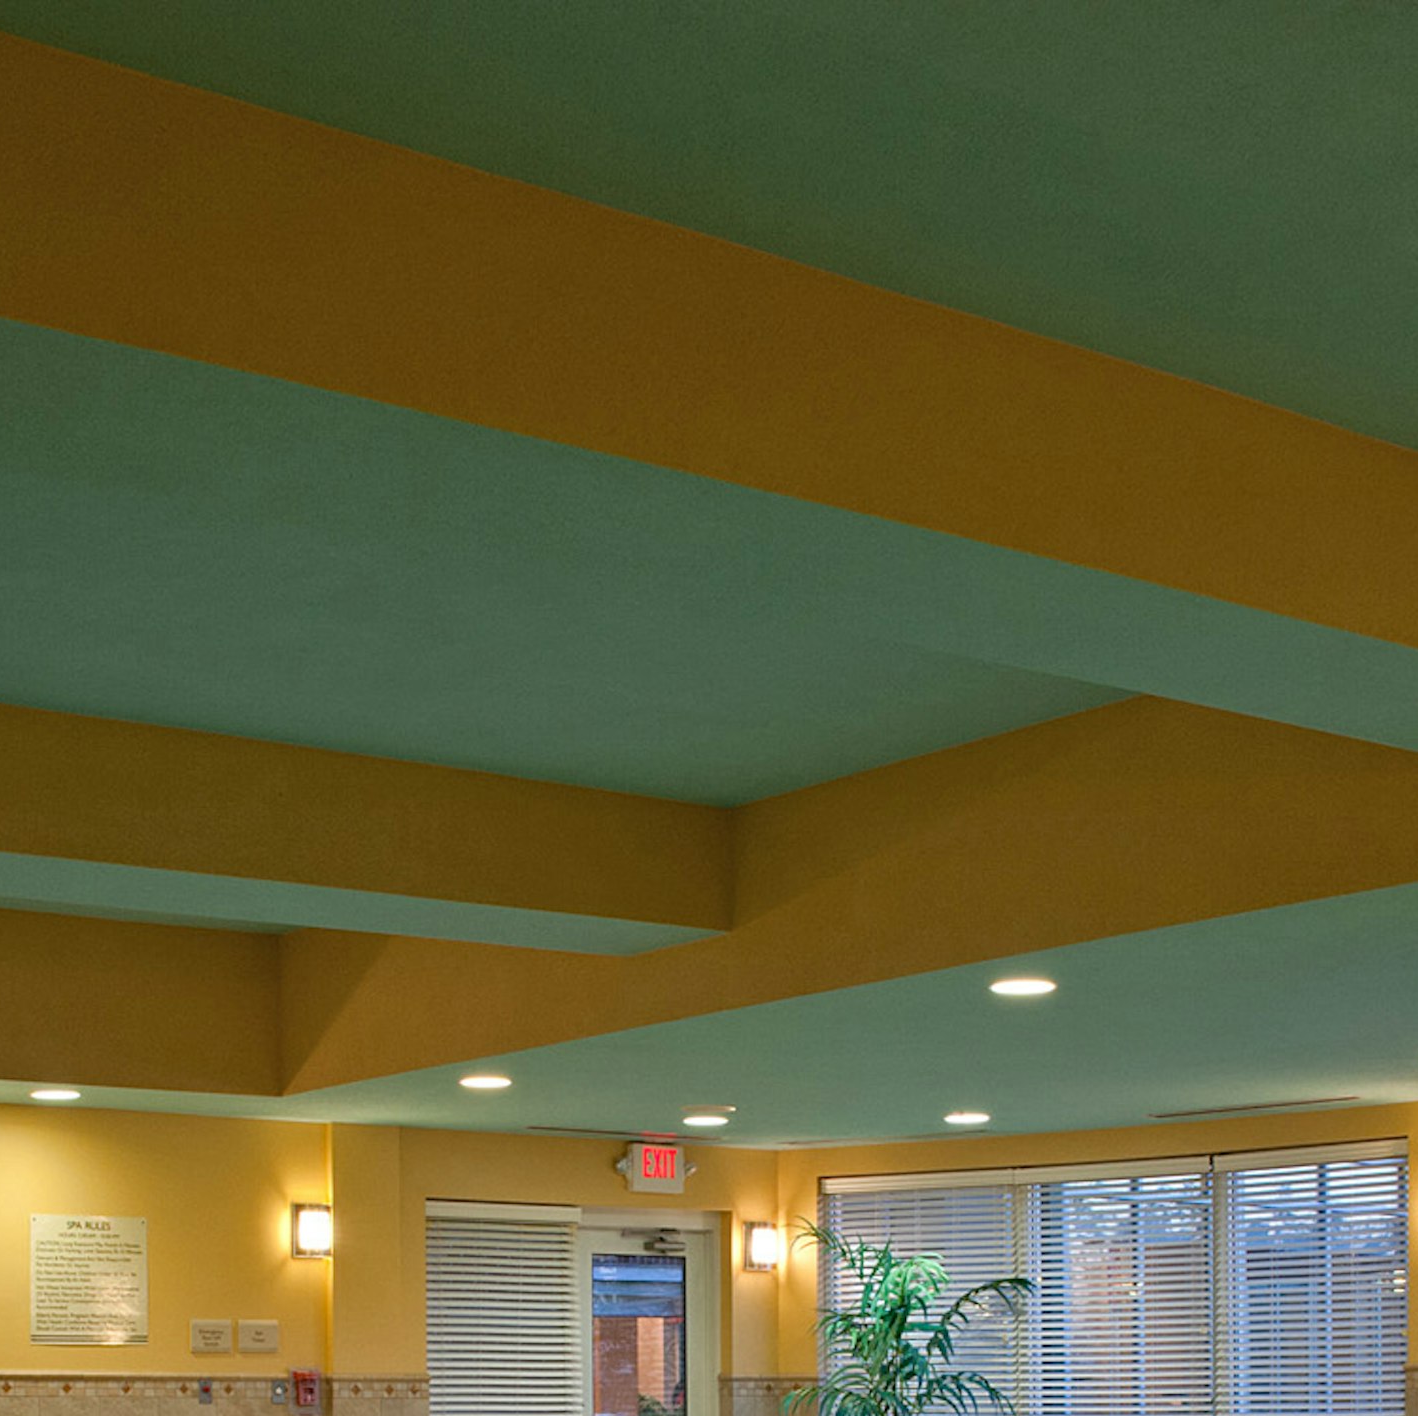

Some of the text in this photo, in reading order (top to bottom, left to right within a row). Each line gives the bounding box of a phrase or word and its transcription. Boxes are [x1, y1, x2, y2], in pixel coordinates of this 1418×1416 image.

[642, 1146, 678, 1180] EXIT
[67, 1221, 111, 1231] SPA RULES
